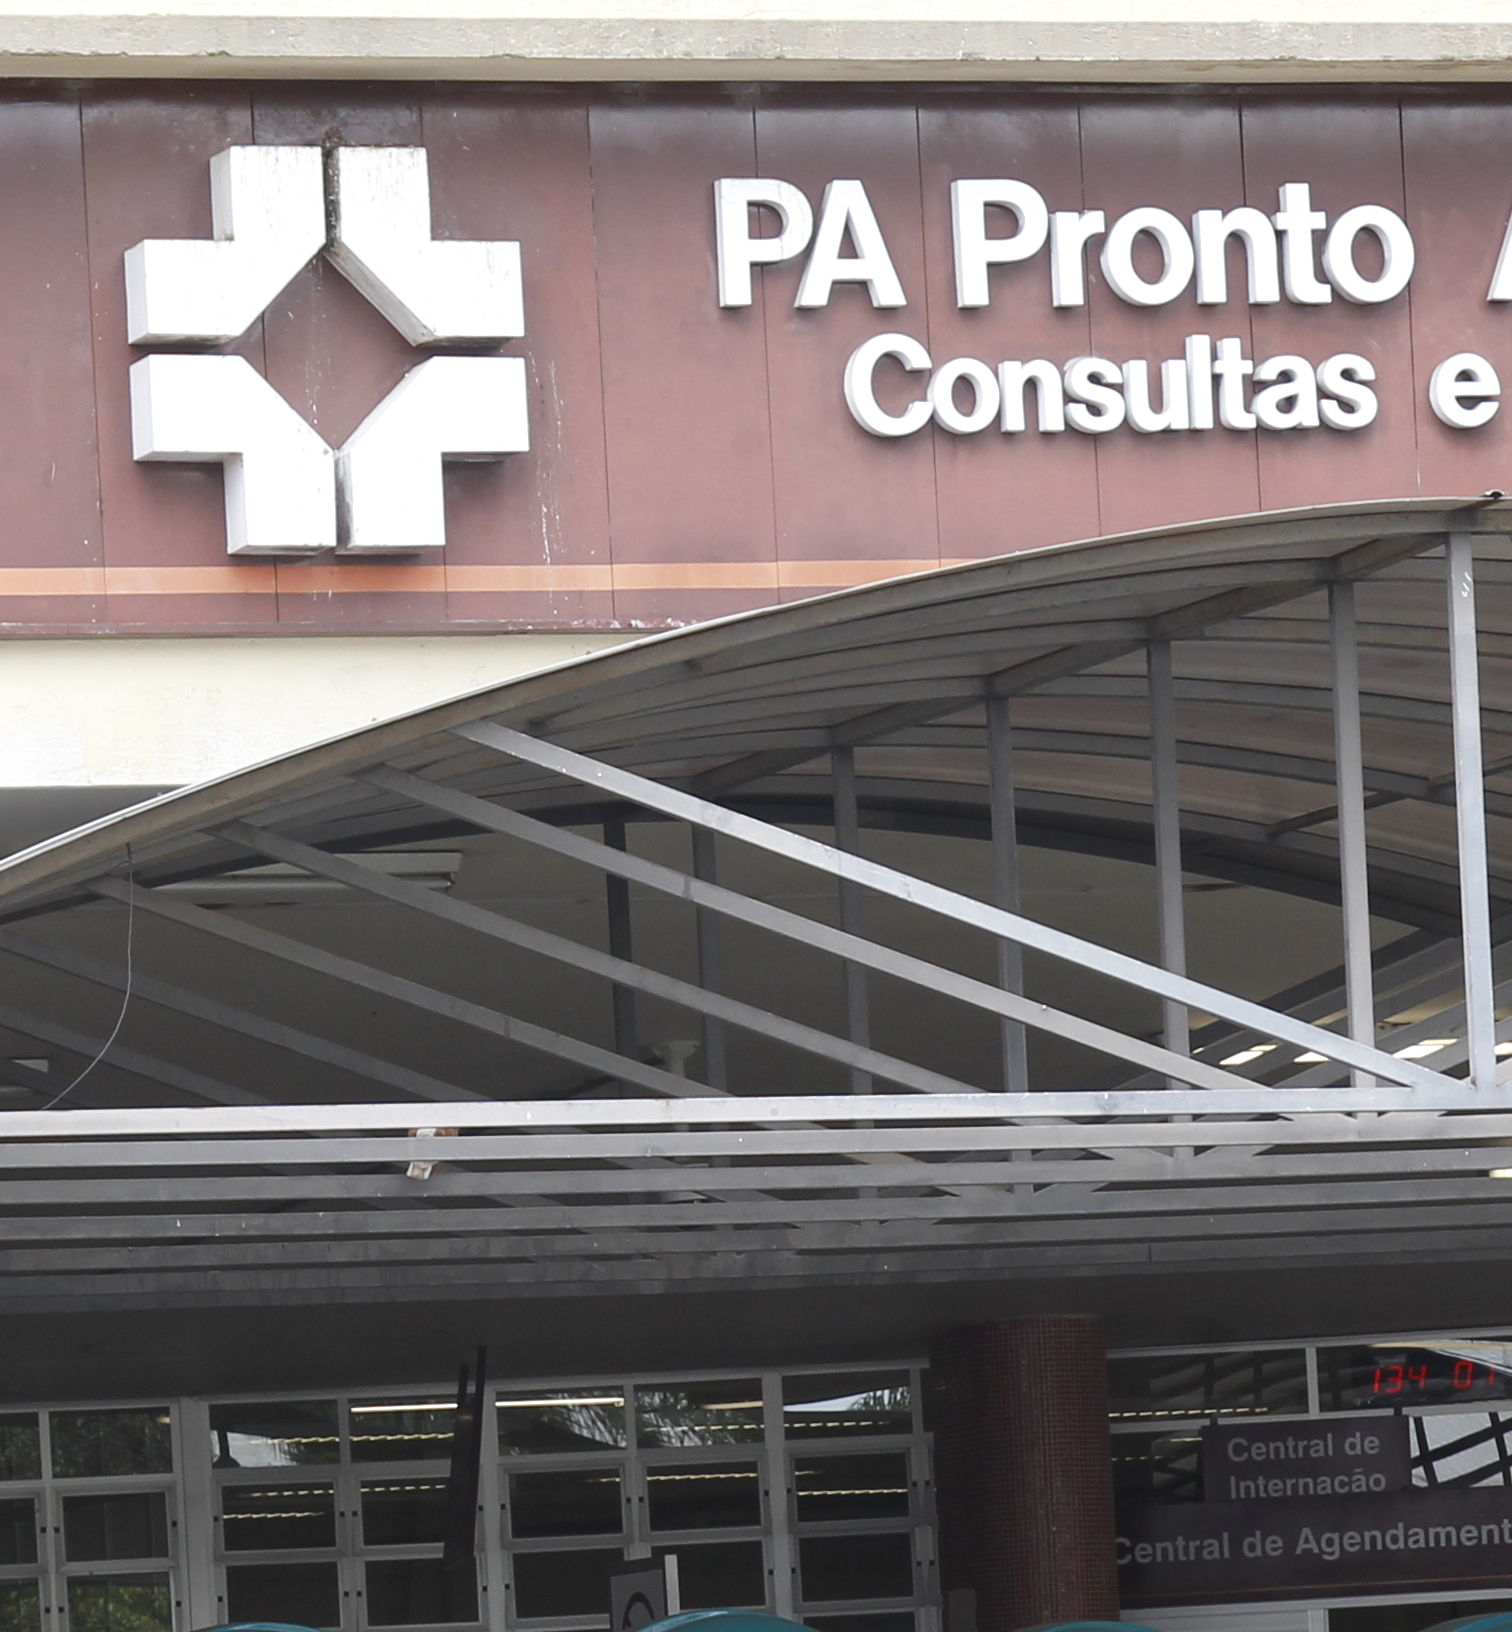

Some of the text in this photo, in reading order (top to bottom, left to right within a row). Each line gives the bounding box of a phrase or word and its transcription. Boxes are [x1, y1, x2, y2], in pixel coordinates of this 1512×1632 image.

[714, 177, 908, 309] PA
[950, 177, 1416, 309] Pronto
[843, 331, 1379, 438] Consultas
[1428, 352, 1502, 430] e
[1372, 1360, 1497, 1394] 134 01
[1227, 1431, 1381, 1462] Central de
[1115, 1531, 1230, 1566] Central
[1241, 1530, 1284, 1558] de
